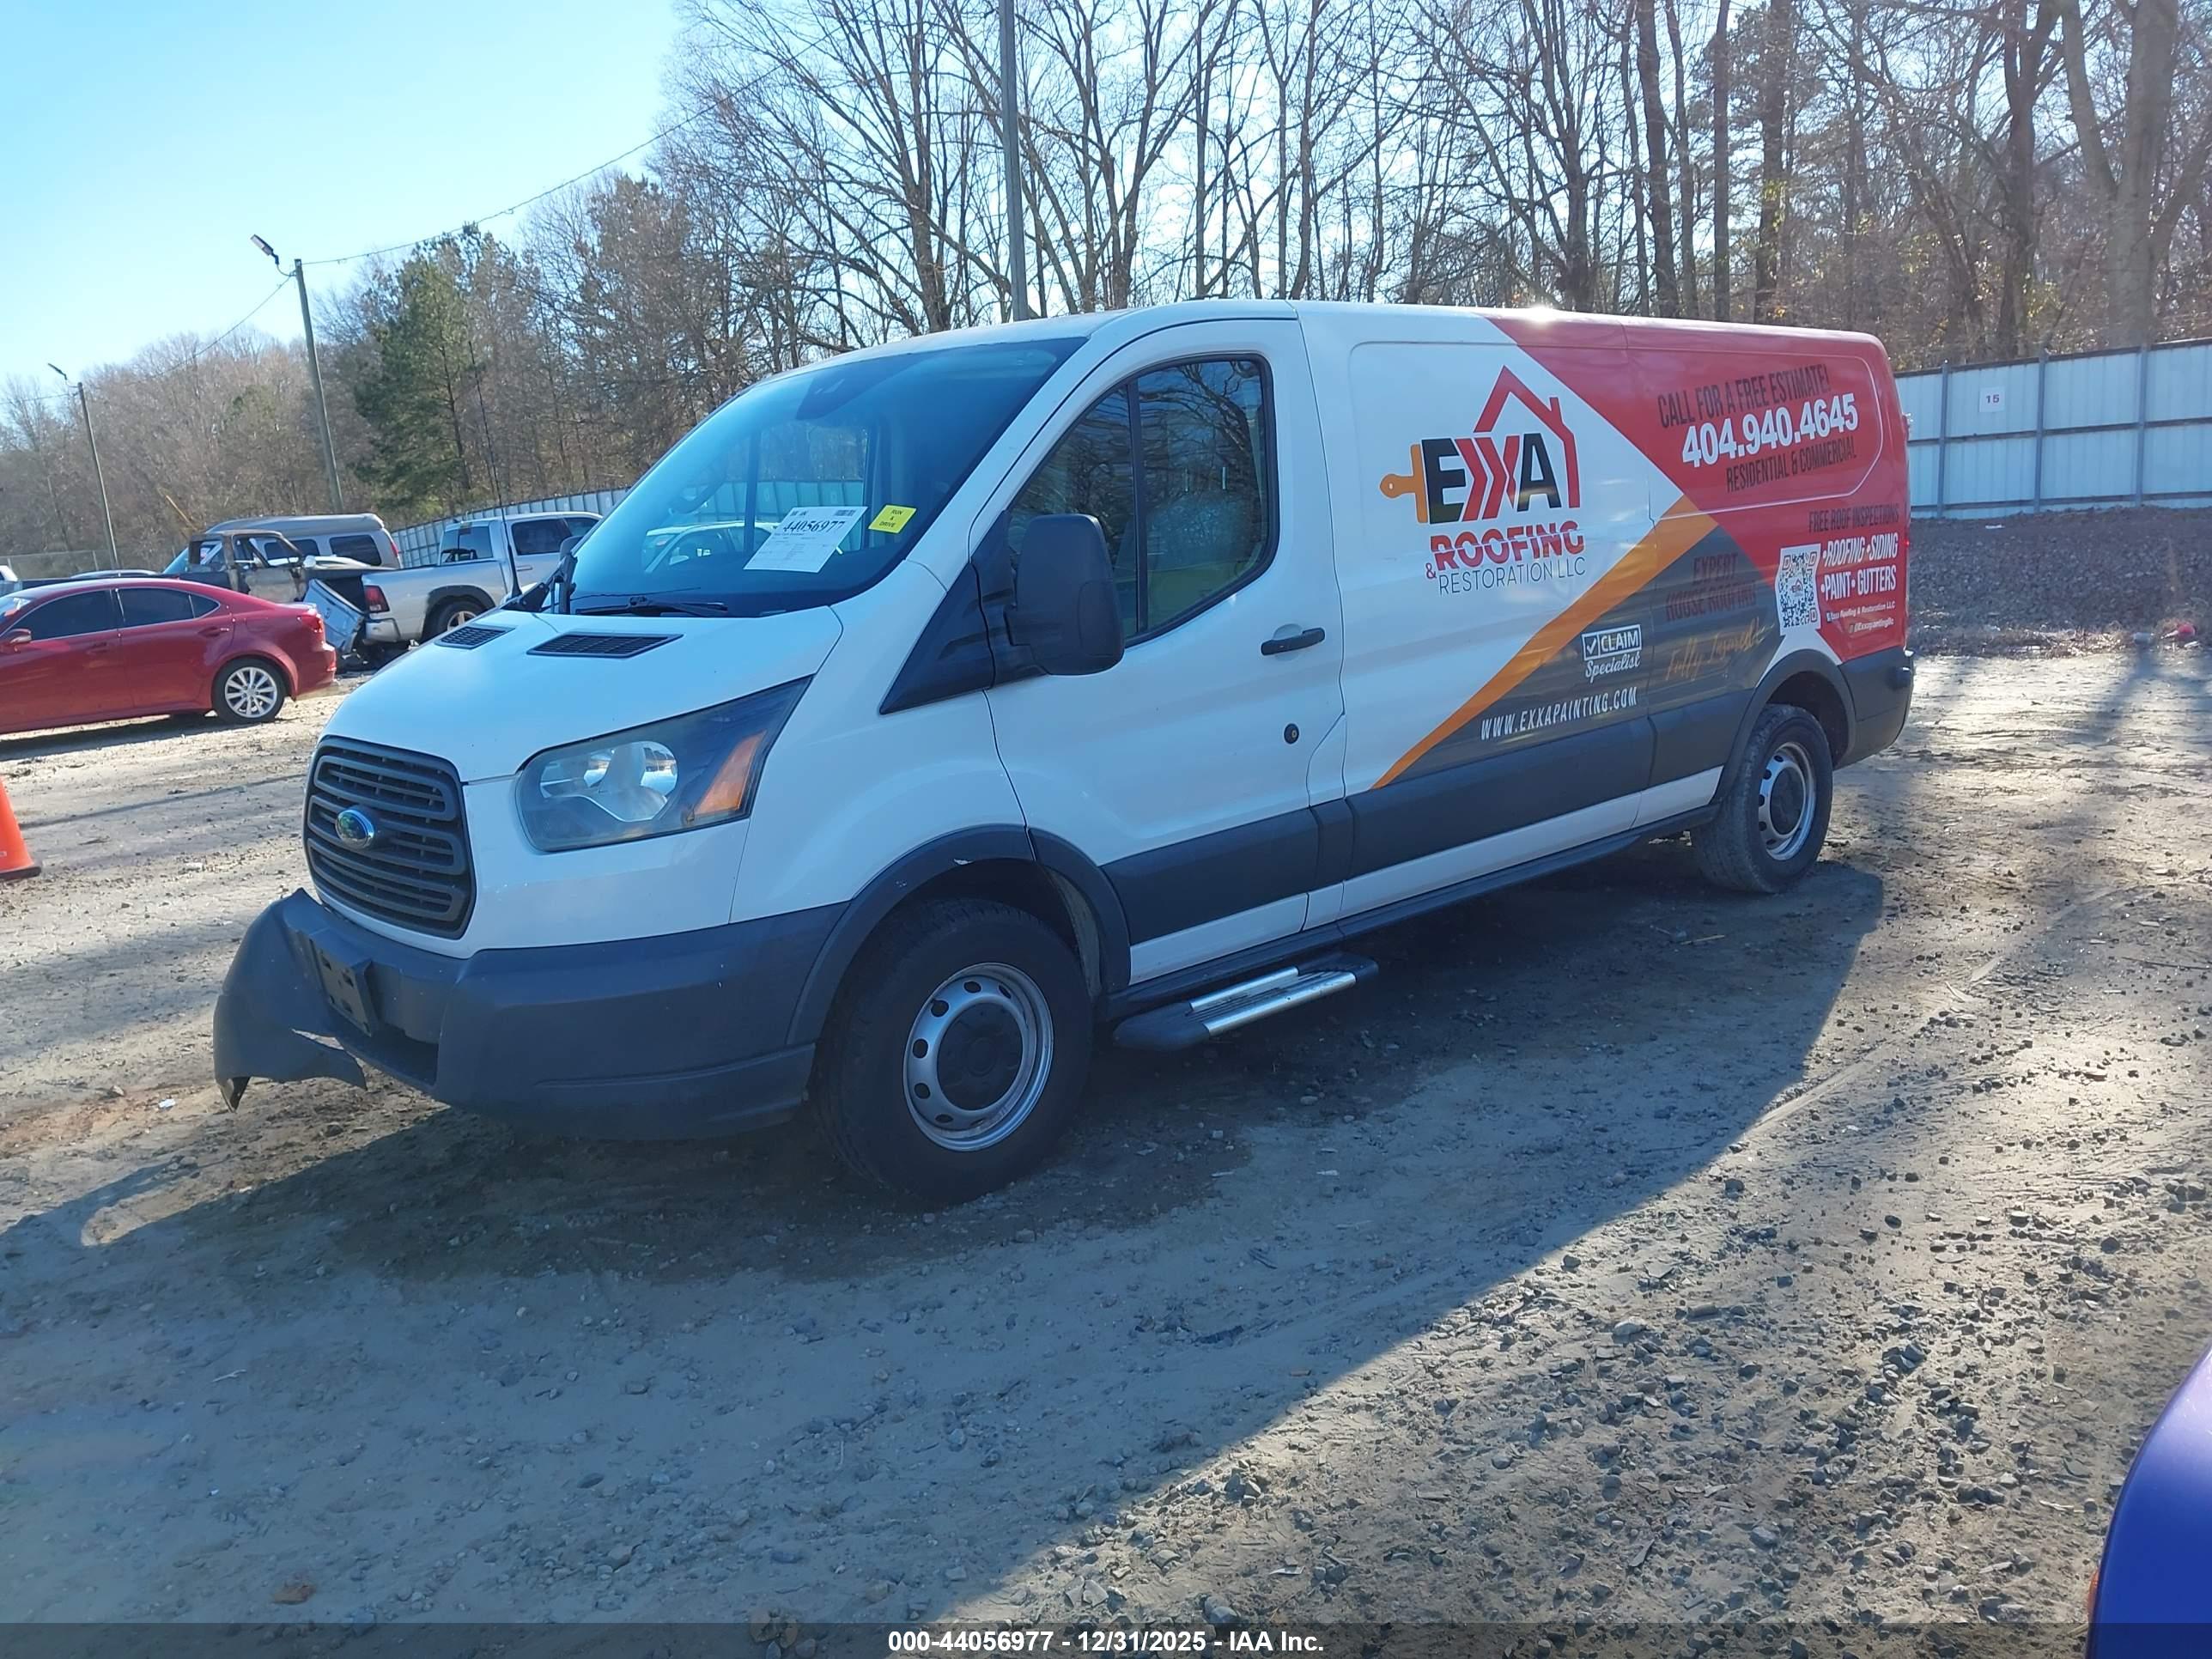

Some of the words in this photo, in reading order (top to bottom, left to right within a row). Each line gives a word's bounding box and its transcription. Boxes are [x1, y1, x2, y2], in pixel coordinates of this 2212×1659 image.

[1657, 389, 1695, 428] CALL
[1696, 383, 1724, 421] FOR
[1725, 383, 1736, 414] A
[1736, 375, 1770, 410] FREE
[1771, 364, 1830, 402] ESTIMATE!
[1985, 394, 2000, 404] 15
[1682, 392, 1858, 468] 404.940.4645
[1726, 453, 1790, 493] RESIDENTIAL
[1790, 453, 1798, 475] &
[1799, 436, 1857, 472] COMMERCIAL
[783, 520, 846, 532] 44056977
[1809, 510, 1829, 533] FREE
[1831, 507, 1850, 531] ROOF
[1430, 520, 1584, 571] ROOFING
[1425, 562, 1437, 579] &
[1438, 563, 1553, 595] RESTORATION
[1556, 556, 1586, 579] LLC
[1857, 564, 1897, 596] GUTTERS
[1887, 600, 1896, 609] LLC
[1601, 631, 1639, 652] CLAIM
[1585, 652, 1640, 683] Specialist
[1480, 687, 1638, 741] WWW.EXXAPAINTING.COM
